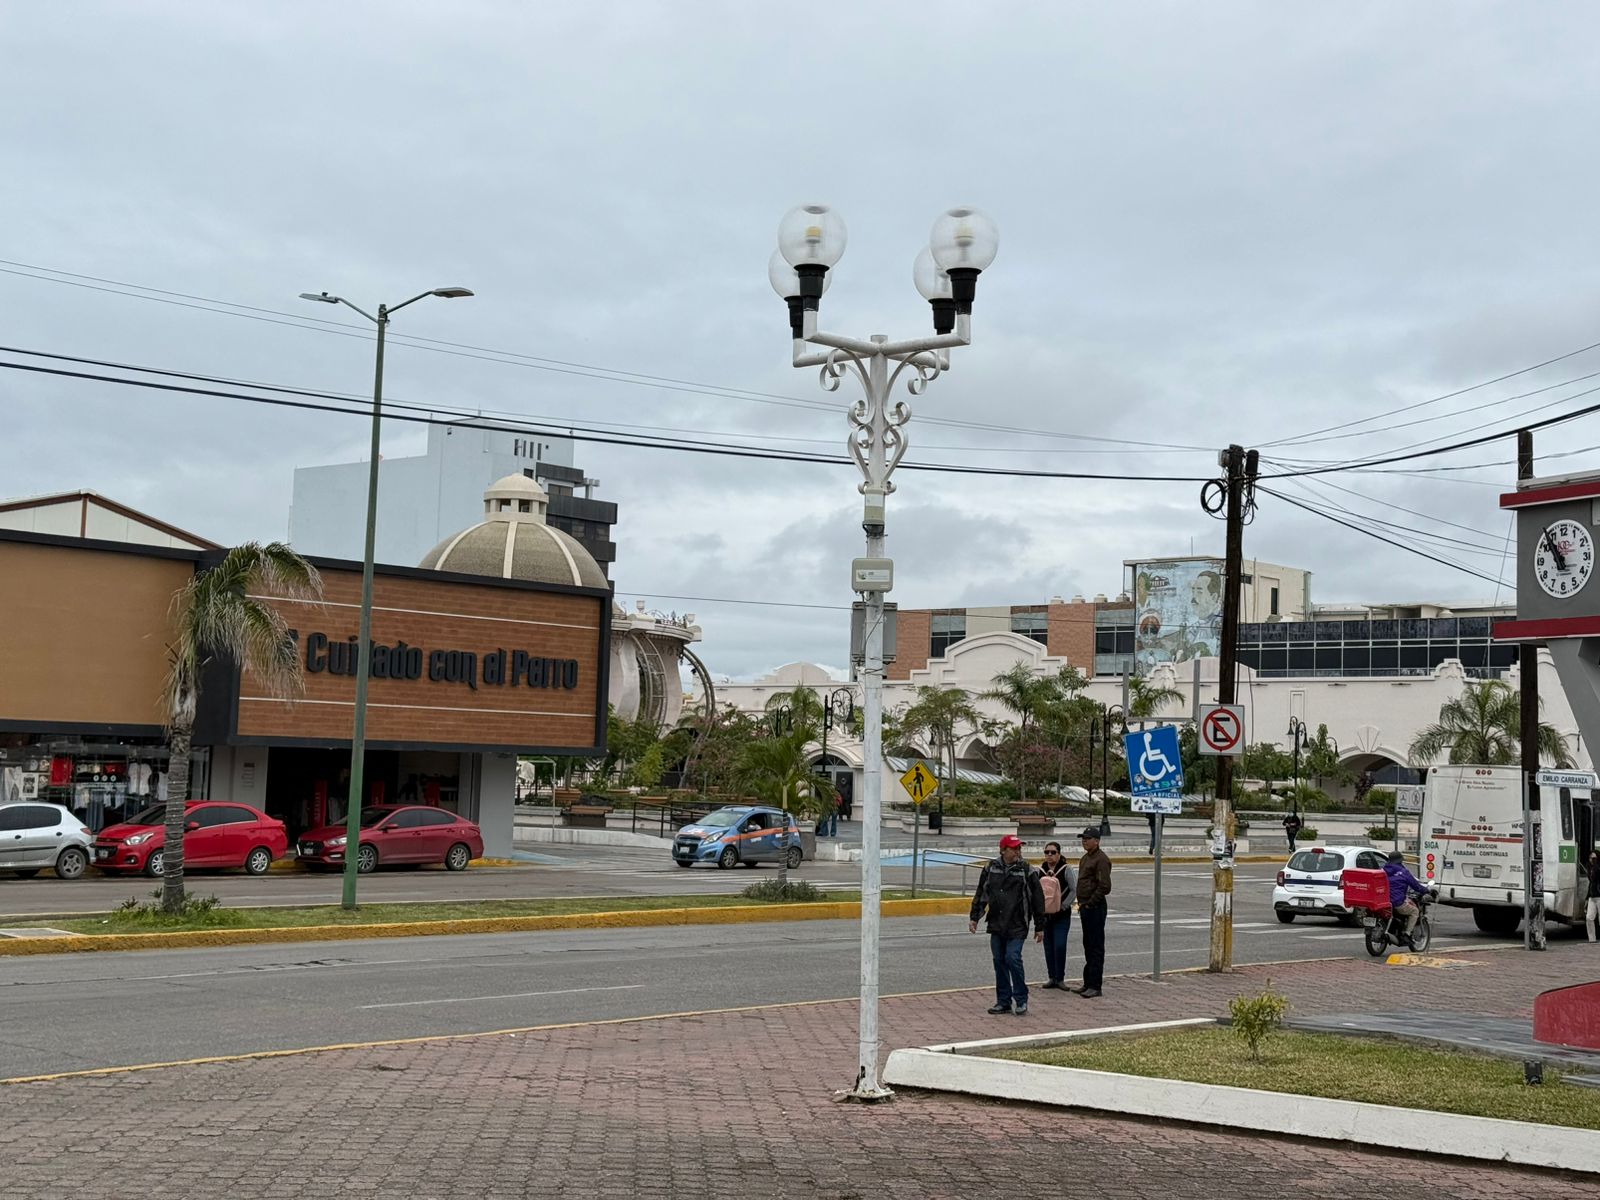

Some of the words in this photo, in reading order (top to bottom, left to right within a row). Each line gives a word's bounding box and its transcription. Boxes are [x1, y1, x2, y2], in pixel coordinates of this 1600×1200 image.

[1560, 527, 1568, 536] 12
[1572, 529, 1576, 538] 1
[1579, 538, 1585, 547] 2
[1583, 552, 1588, 561] 3
[1539, 557, 1545, 566] 9
[1579, 565, 1585, 574] 4
[1543, 570, 1548, 579] 8
[1551, 578, 1556, 588] 7
[1571, 576, 1577, 586] 5
[1560, 581, 1566, 591] 6
[429, 650, 477, 690] con
[483, 647, 507, 686] el
[511, 649, 578, 689] Perro
[1542, 774, 1559, 783] EMILIO
[1560, 776, 1588, 784] CARRANZA
[1424, 841, 1439, 849] SIGA
